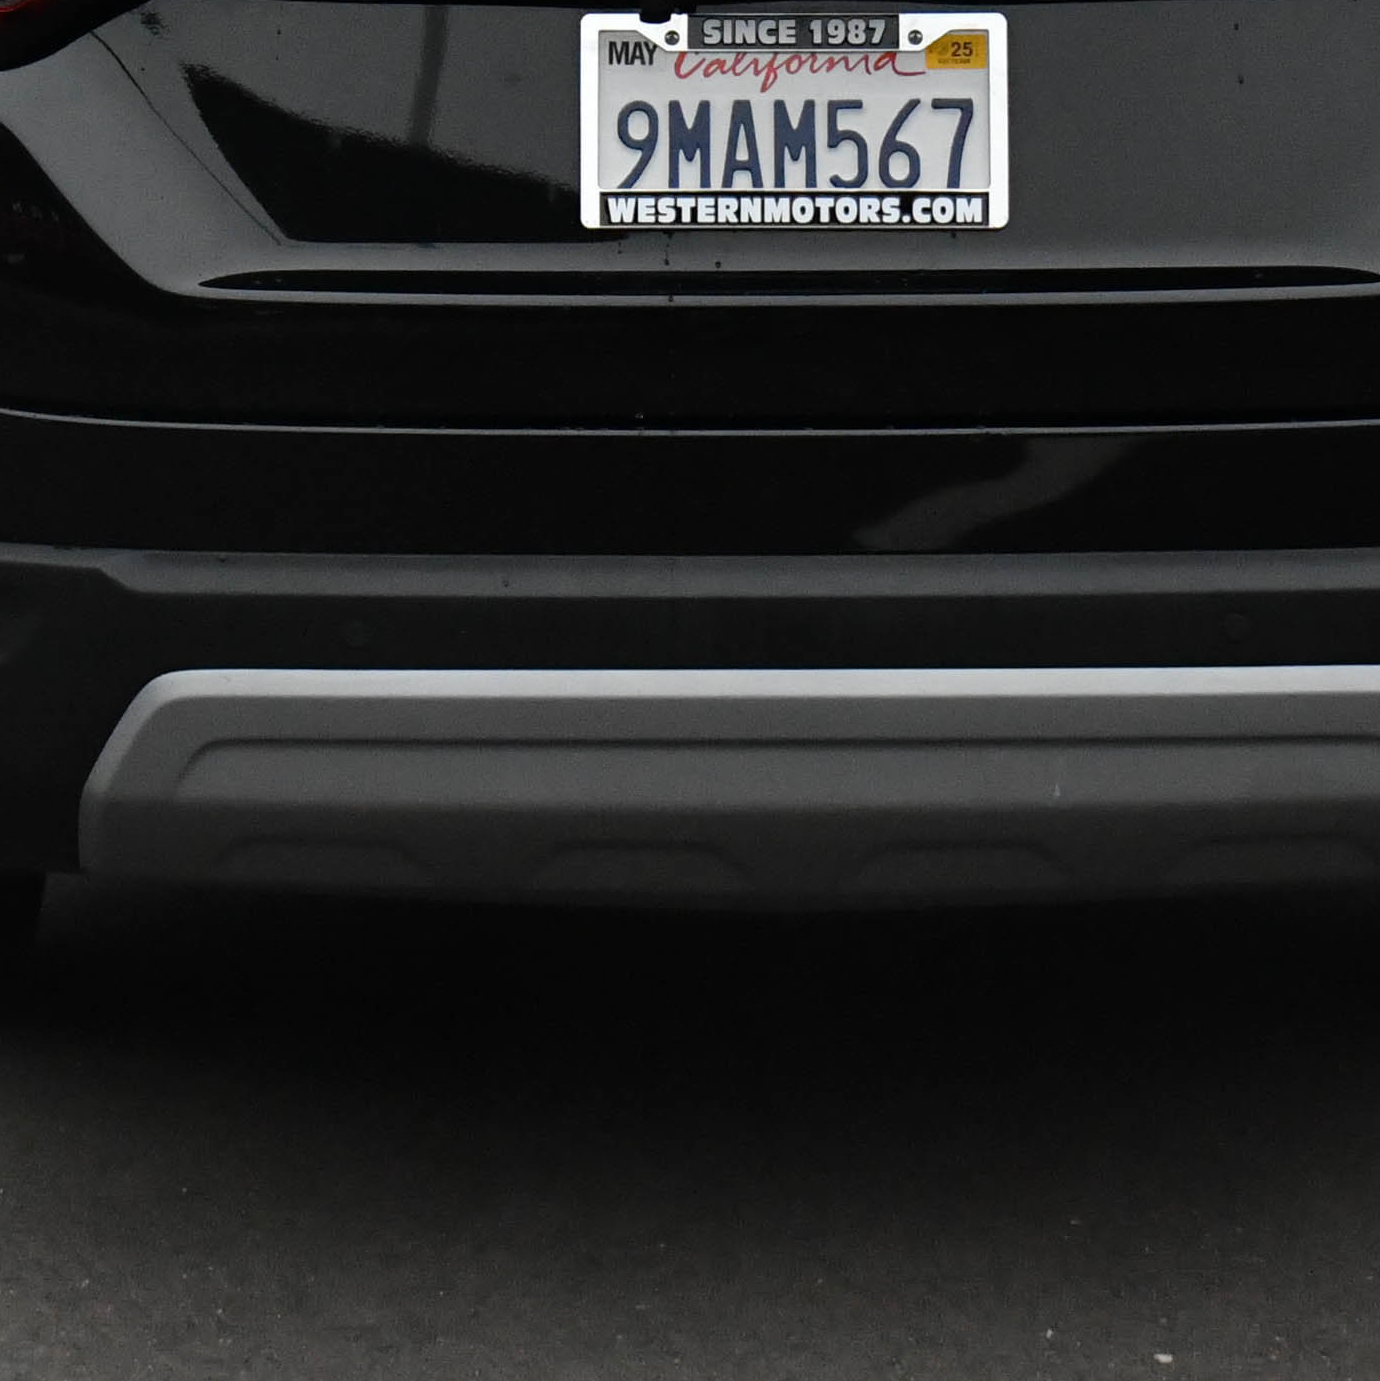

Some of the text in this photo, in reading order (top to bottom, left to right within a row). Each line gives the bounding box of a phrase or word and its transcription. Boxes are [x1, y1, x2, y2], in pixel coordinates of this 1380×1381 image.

[702, 18, 887, 46] SINCE 1987
[607, 41, 658, 66] MAY
[950, 41, 973, 57] 25
[674, 51, 927, 93] California
[617, 98, 974, 189] 9MAM567
[607, 196, 984, 225] WESTERNMOTORS.COM
